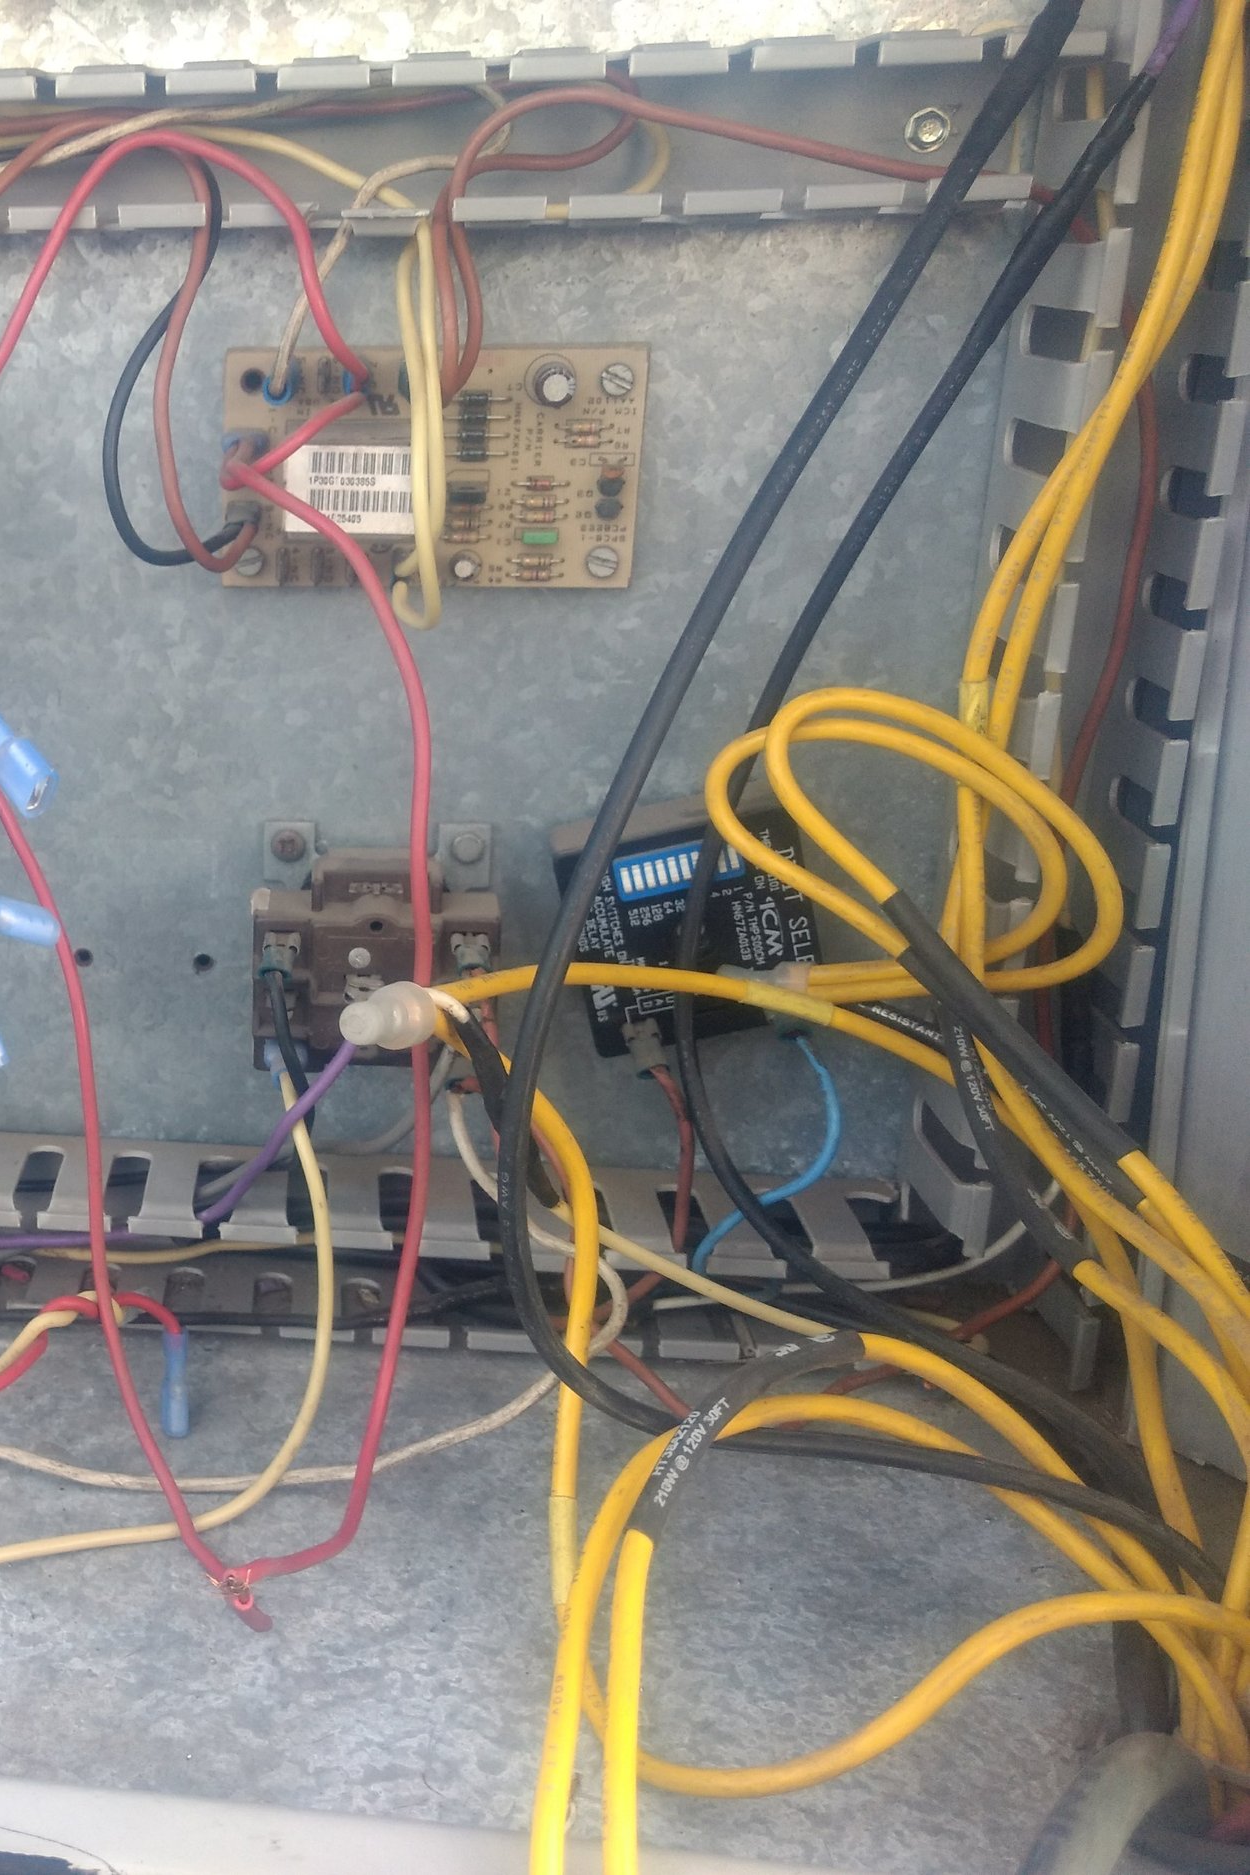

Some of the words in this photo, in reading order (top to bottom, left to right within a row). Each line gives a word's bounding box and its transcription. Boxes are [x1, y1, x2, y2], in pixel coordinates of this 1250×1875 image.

[534, 412, 545, 467] CARRIER
[710, 891, 722, 899] 4
[721, 888, 732, 897] 2
[742, 892, 756, 913] P/N
[650, 903, 664, 922] 128
[662, 900, 674, 915] 64
[674, 897, 686, 913] 32
[594, 895, 616, 959] ACCUMULATE
[627, 909, 641, 927] 512
[639, 906, 653, 927] 256
[585, 918, 601, 951] DELAY
[759, 901, 784, 956] ICM
[871, 1005, 944, 1042] RESISTANT
[953, 1025, 969, 1058] 210W
[965, 1074, 983, 1102] 120V
[976, 1104, 996, 1132] 30FT
[653, 1467, 680, 1508] 210W
[674, 1454, 690, 1471] @
[682, 1422, 709, 1455] 120V
[702, 1396, 731, 1427] 30FT
